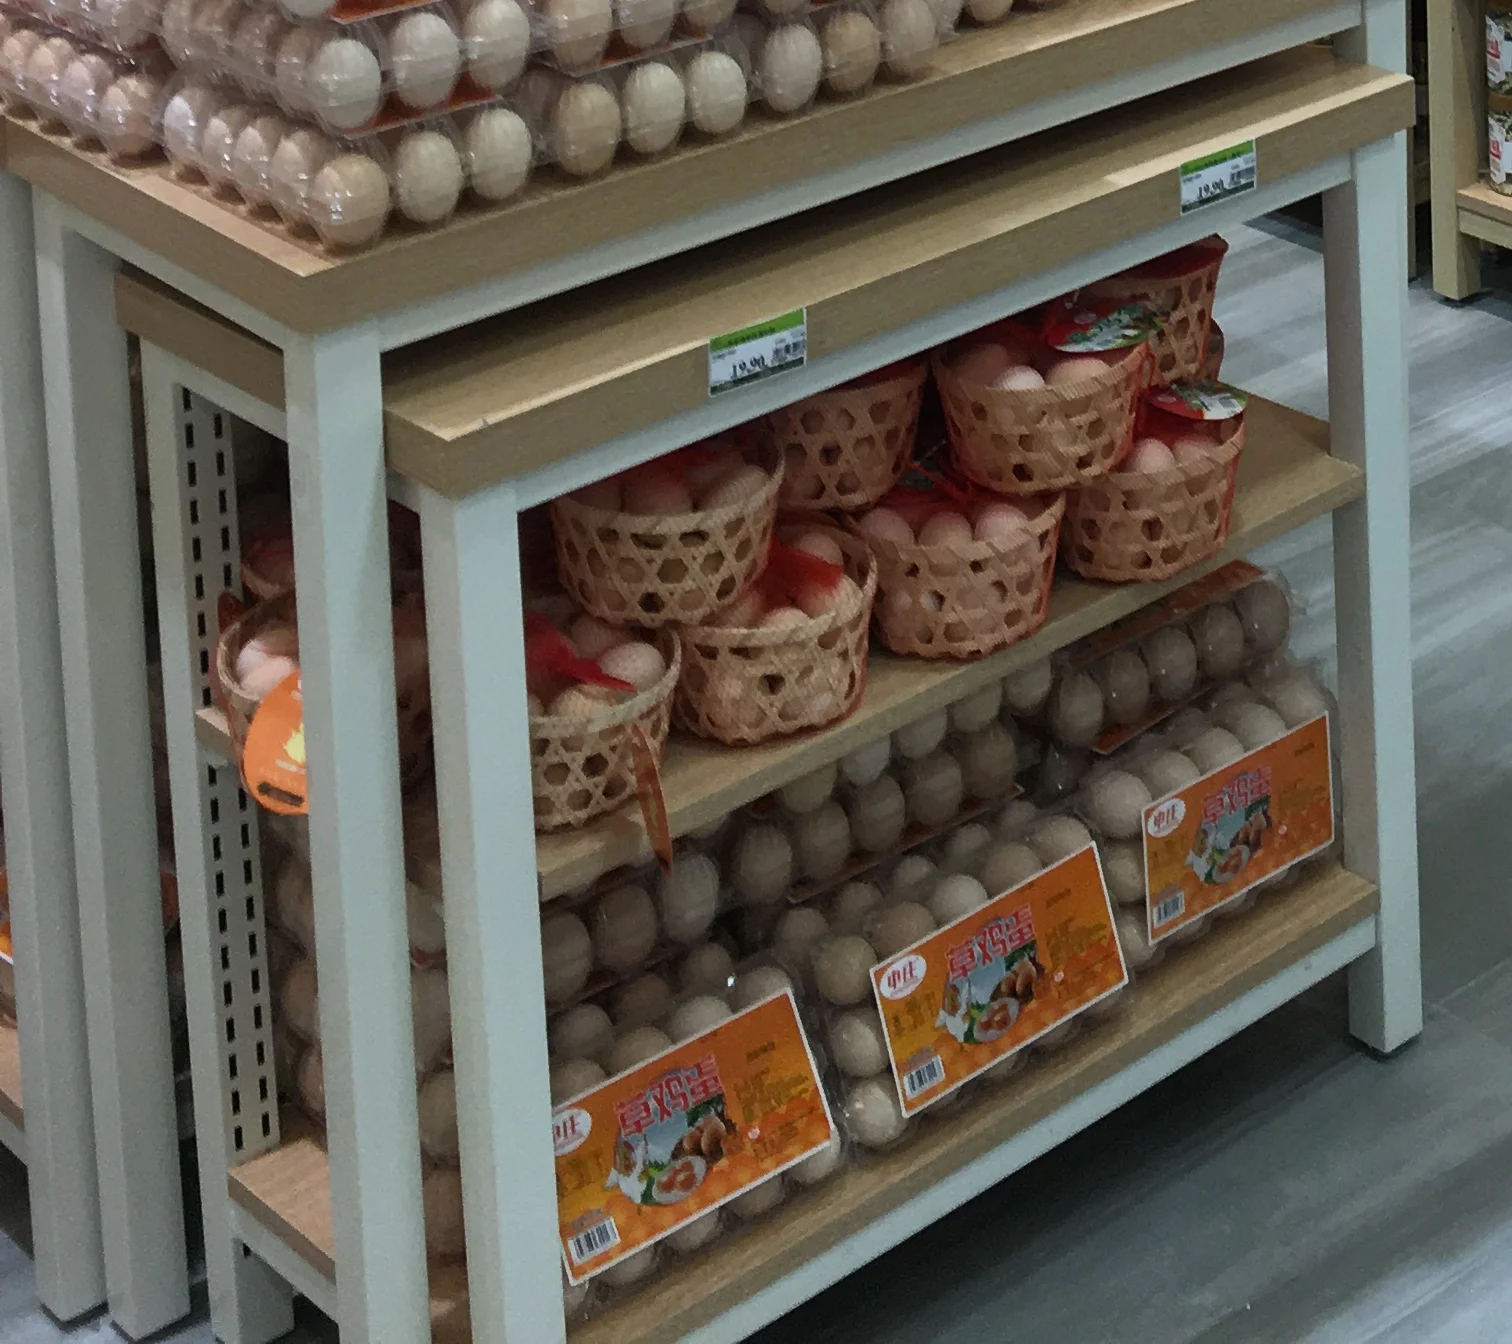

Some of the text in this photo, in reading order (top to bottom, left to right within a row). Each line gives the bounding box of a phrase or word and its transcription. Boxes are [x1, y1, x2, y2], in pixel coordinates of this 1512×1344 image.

[731, 354, 767, 379] 19.90
[1202, 764, 1273, 826] 草鸡蛋
[944, 902, 1037, 981] 草鸡蛋
[613, 1052, 726, 1138] 草鸡蛋
